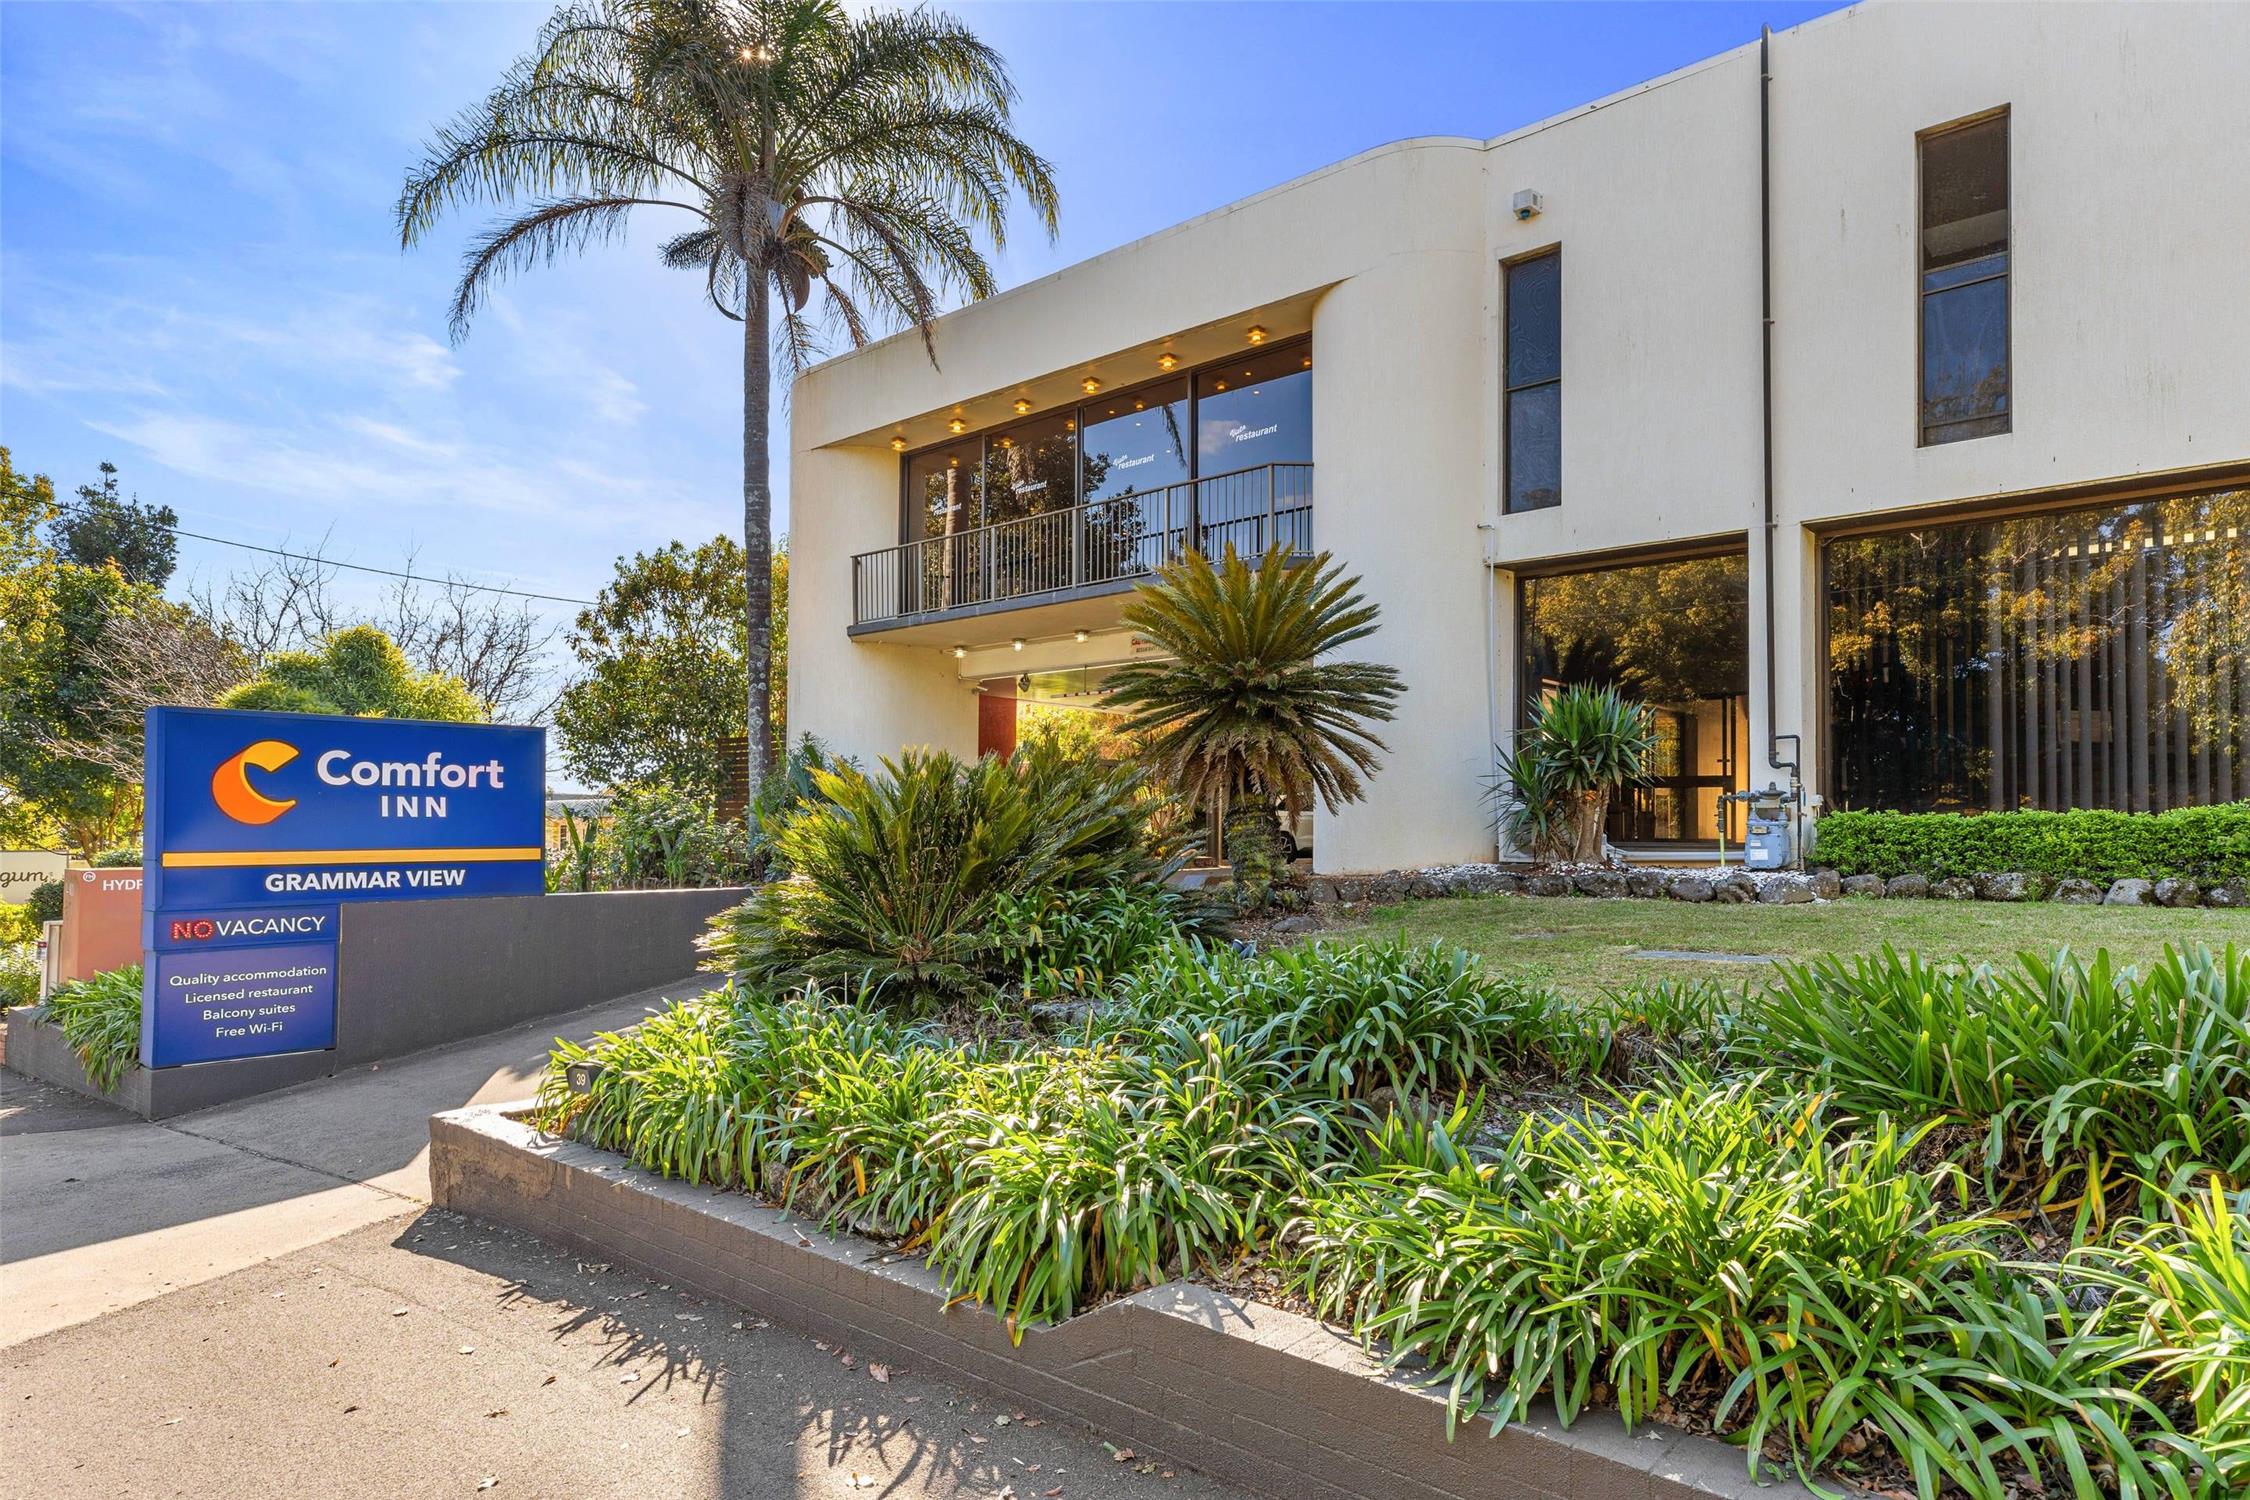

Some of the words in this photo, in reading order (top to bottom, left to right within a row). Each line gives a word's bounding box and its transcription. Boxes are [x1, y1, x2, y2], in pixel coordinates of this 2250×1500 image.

[1235, 424, 1278, 442] restaurant
[1118, 453, 1155, 470] restaurant
[316, 750, 504, 789] Comfort
[381, 796, 447, 818] INN
[265, 871, 401, 892] GRAMMAR
[405, 869, 466, 887] VIEW
[172, 920, 214, 940] NO
[216, 916, 326, 936] VACANCY
[169, 973, 220, 987] Quality
[223, 966, 327, 983] accommodation
[185, 989, 245, 1004] Licensed
[248, 984, 313, 999] restaurant
[203, 1008, 256, 1021] Balcony
[258, 1004, 296, 1016] suites
[216, 1027, 246, 1038] Free
[249, 1021, 283, 1035] Wi-Fi
